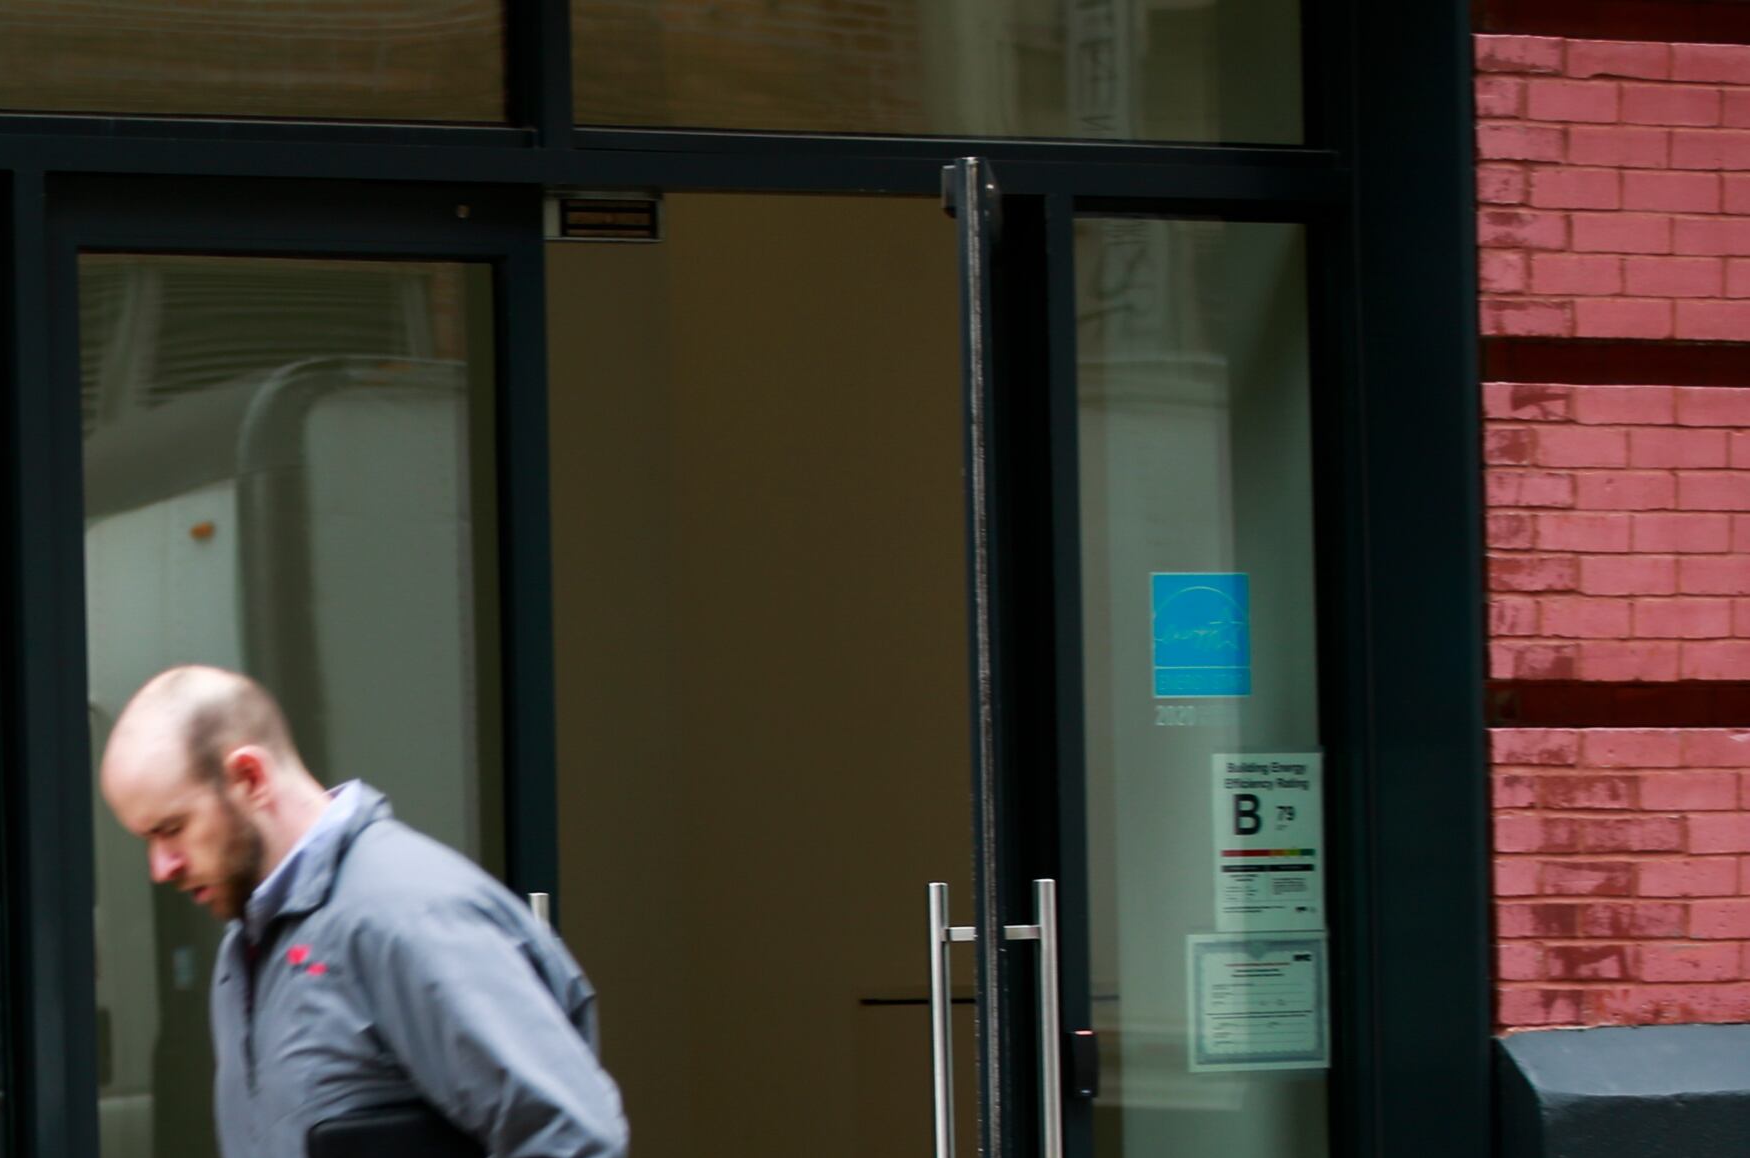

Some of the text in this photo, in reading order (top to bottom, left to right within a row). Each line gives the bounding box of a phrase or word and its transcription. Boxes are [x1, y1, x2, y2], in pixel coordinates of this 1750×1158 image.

[1226, 761, 1307, 776] Building Energy
[1233, 793, 1262, 836] B
